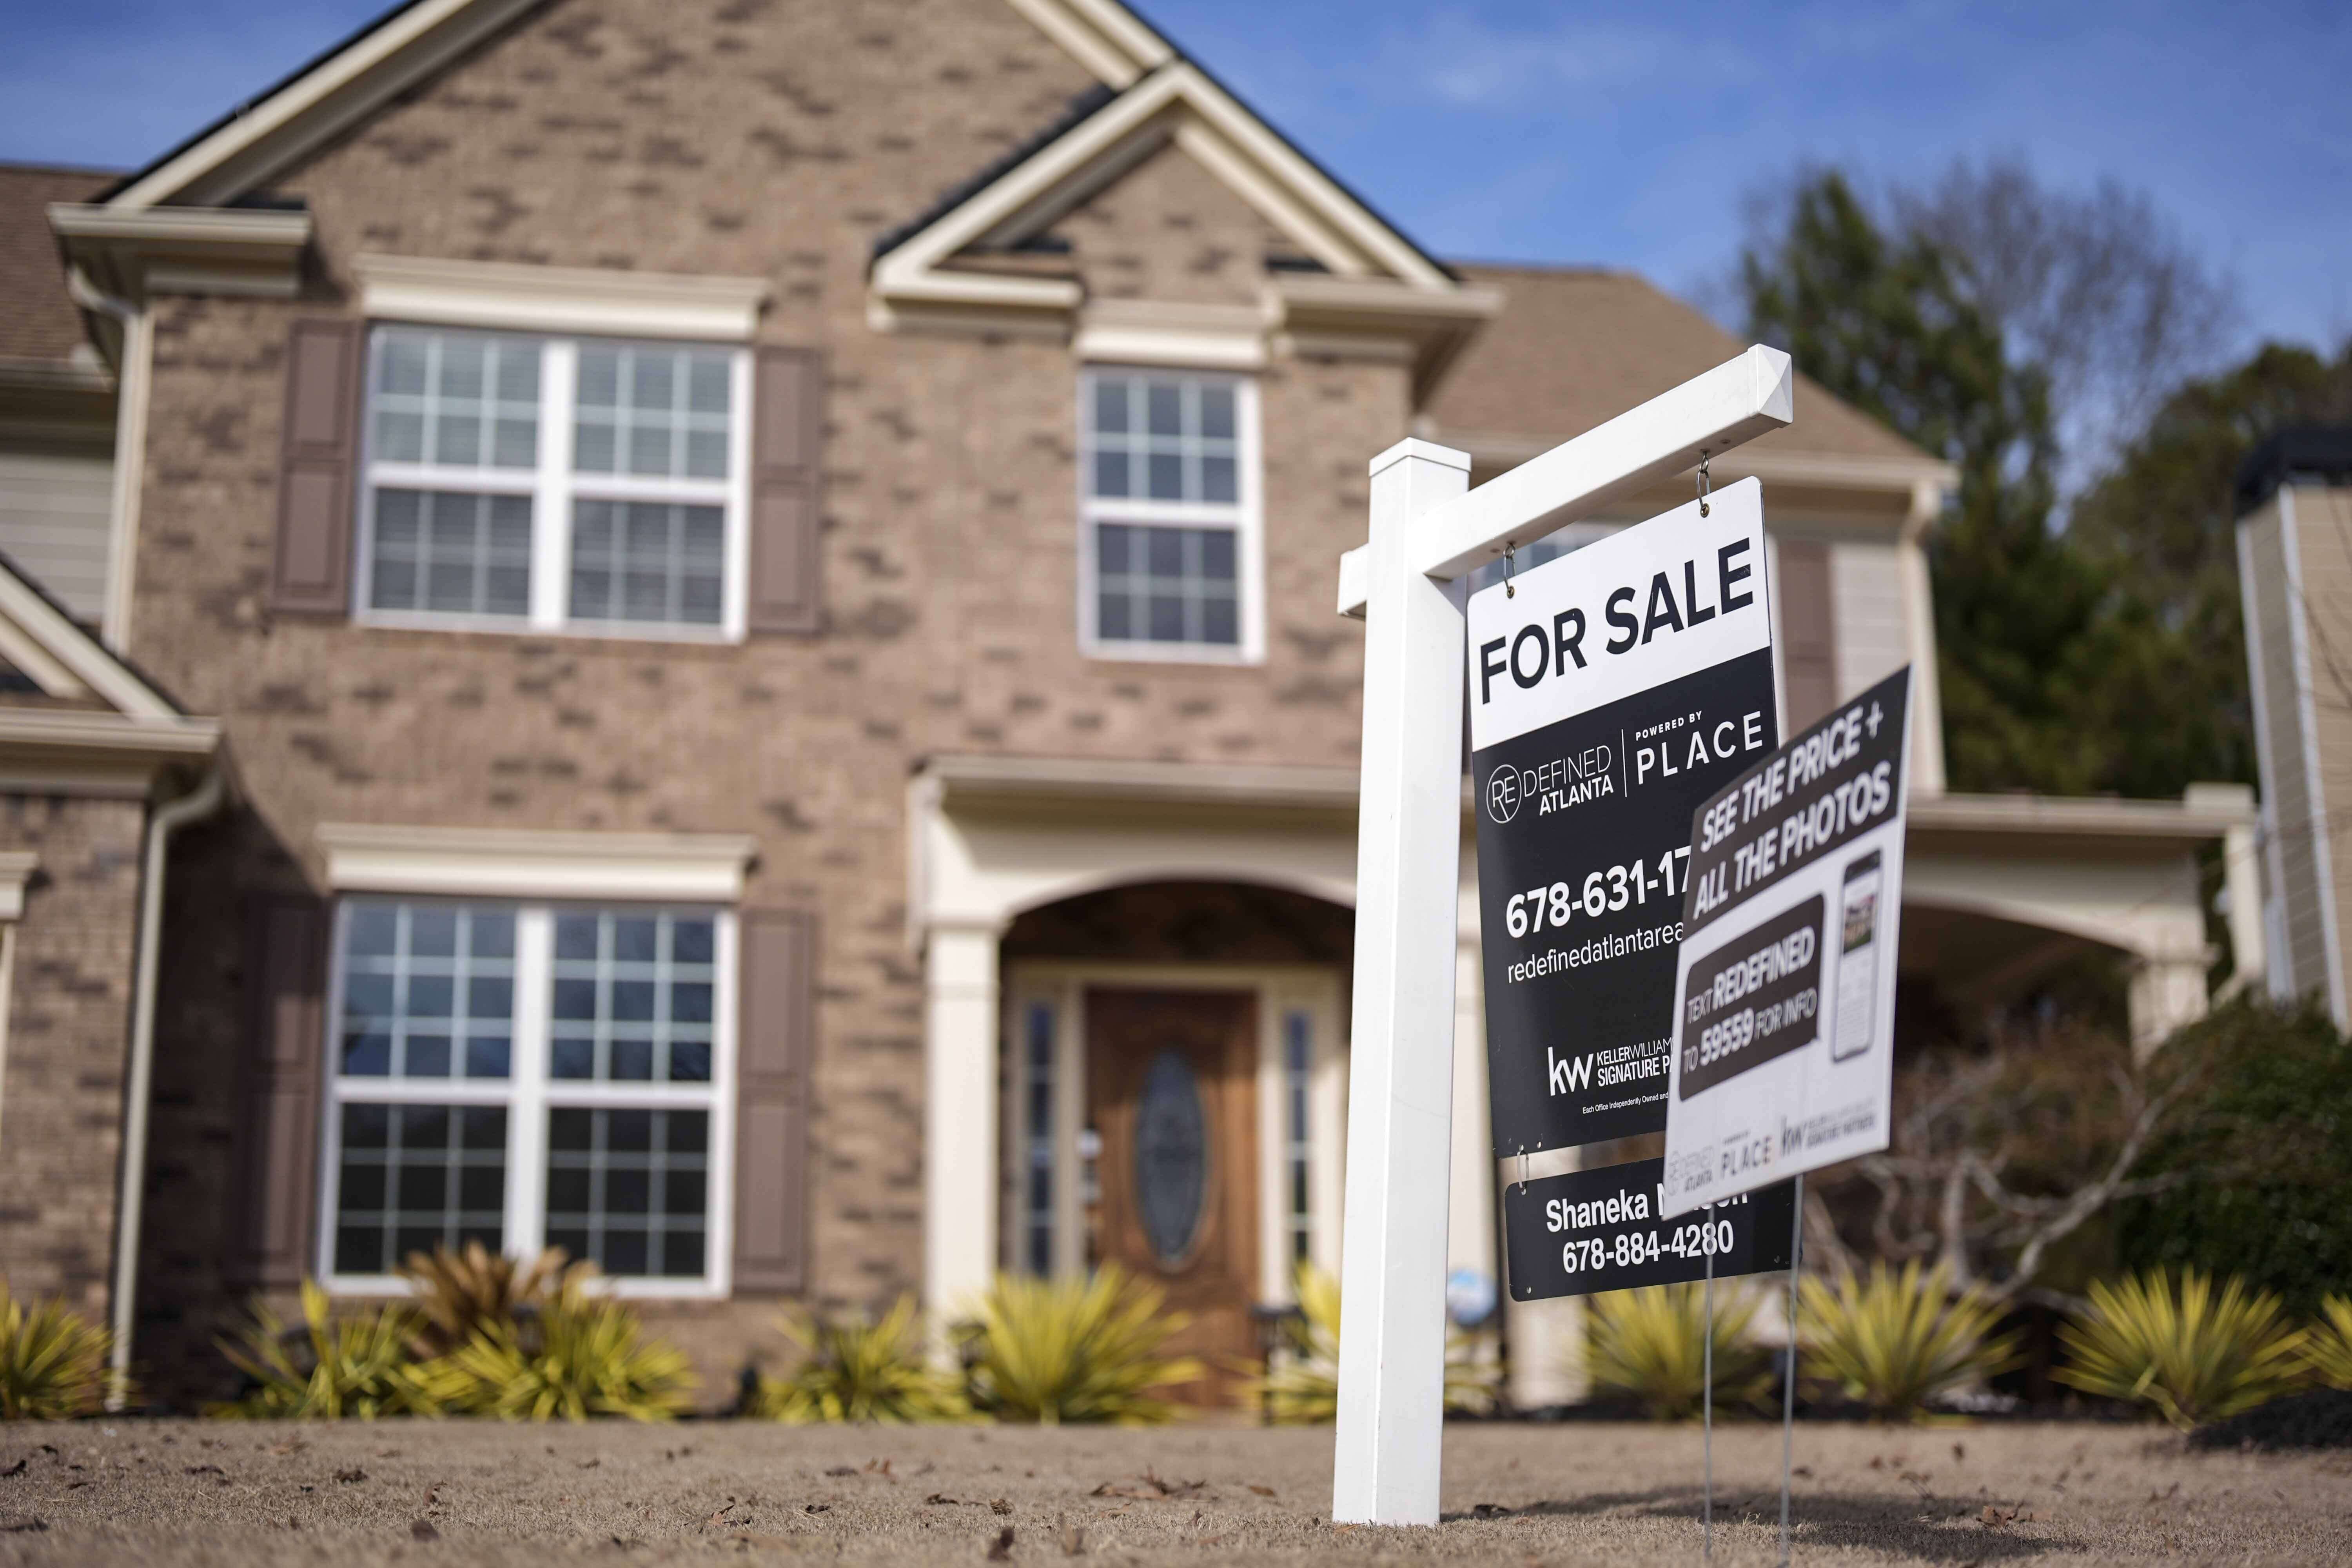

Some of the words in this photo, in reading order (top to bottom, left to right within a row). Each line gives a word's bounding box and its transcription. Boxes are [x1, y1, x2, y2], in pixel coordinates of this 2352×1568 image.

[1480, 608, 1588, 704] FOR
[1605, 537, 1754, 655] SALE
[1635, 717, 1684, 741] POWERED
[1689, 710, 1702, 723] BY
[1637, 711, 1763, 785] PLACE
[1539, 774, 1614, 816] ATLANTA
[1700, 789, 1739, 853] SEE
[1742, 757, 1786, 824] THE
[1787, 706, 1863, 795] PRICE
[1692, 860, 1729, 920] ALL
[1734, 827, 1779, 893] THE
[1779, 760, 1891, 867] PHOTOS
[1687, 988, 1713, 1024] TEXT
[1711, 926, 1816, 1010] REDEFINED
[1683, 1045, 1699, 1074] TO
[1700, 1008, 1755, 1066] 59559
[1755, 1004, 1783, 1040] FOR
[1783, 987, 1818, 1026] INFO
[1597, 1057, 1660, 1087] SIGNATURE
[1583, 1106, 1594, 1114] Each
[1595, 1104, 1608, 1112] Office
[1609, 1097, 1641, 1109] Independently
[1642, 1093, 1659, 1103] Owned
[1660, 1092, 1669, 1100] and
[1720, 1135, 1773, 1179] PLACE
[1546, 1189, 1650, 1232] Shaneka
[1563, 1220, 1734, 1274] 678-884-4280
